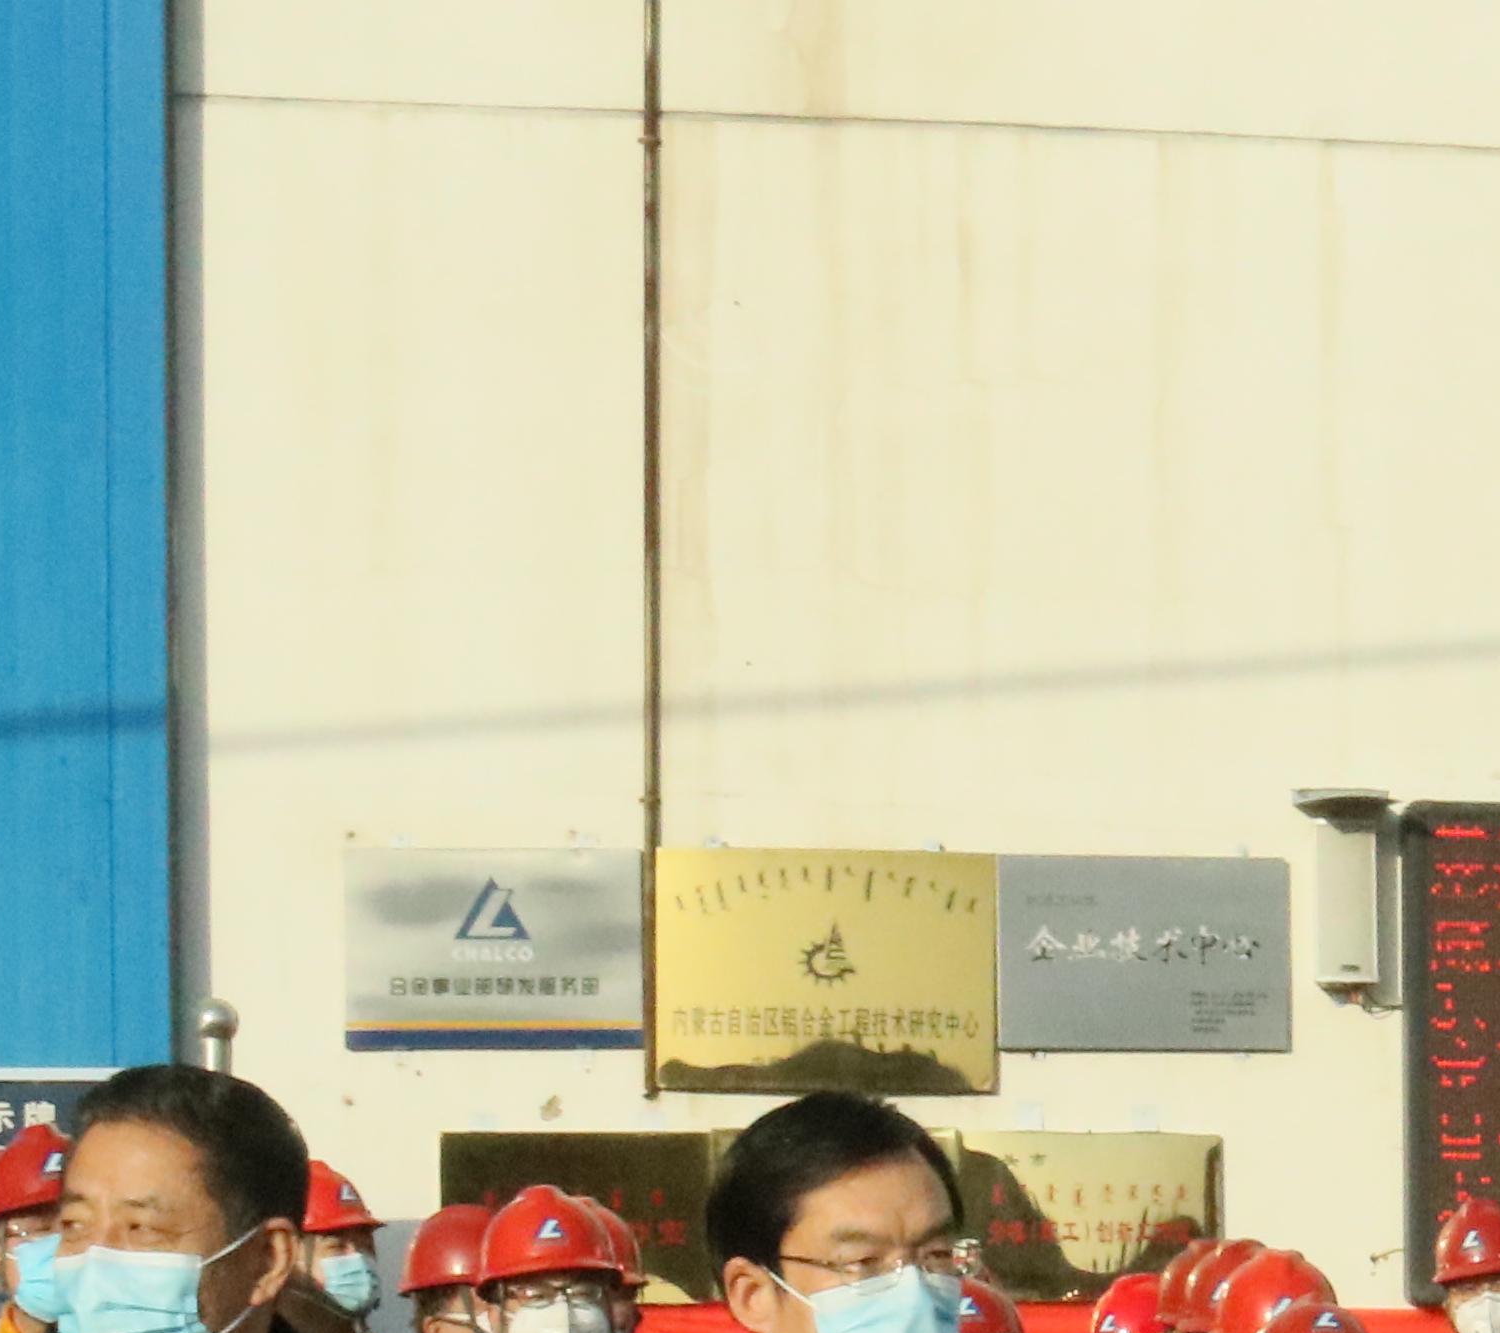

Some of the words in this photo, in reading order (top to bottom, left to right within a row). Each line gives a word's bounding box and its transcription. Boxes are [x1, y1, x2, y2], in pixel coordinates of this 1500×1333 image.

[452, 946, 534, 962] CHALCO
[1025, 924, 1260, 965] 企业技术中心
